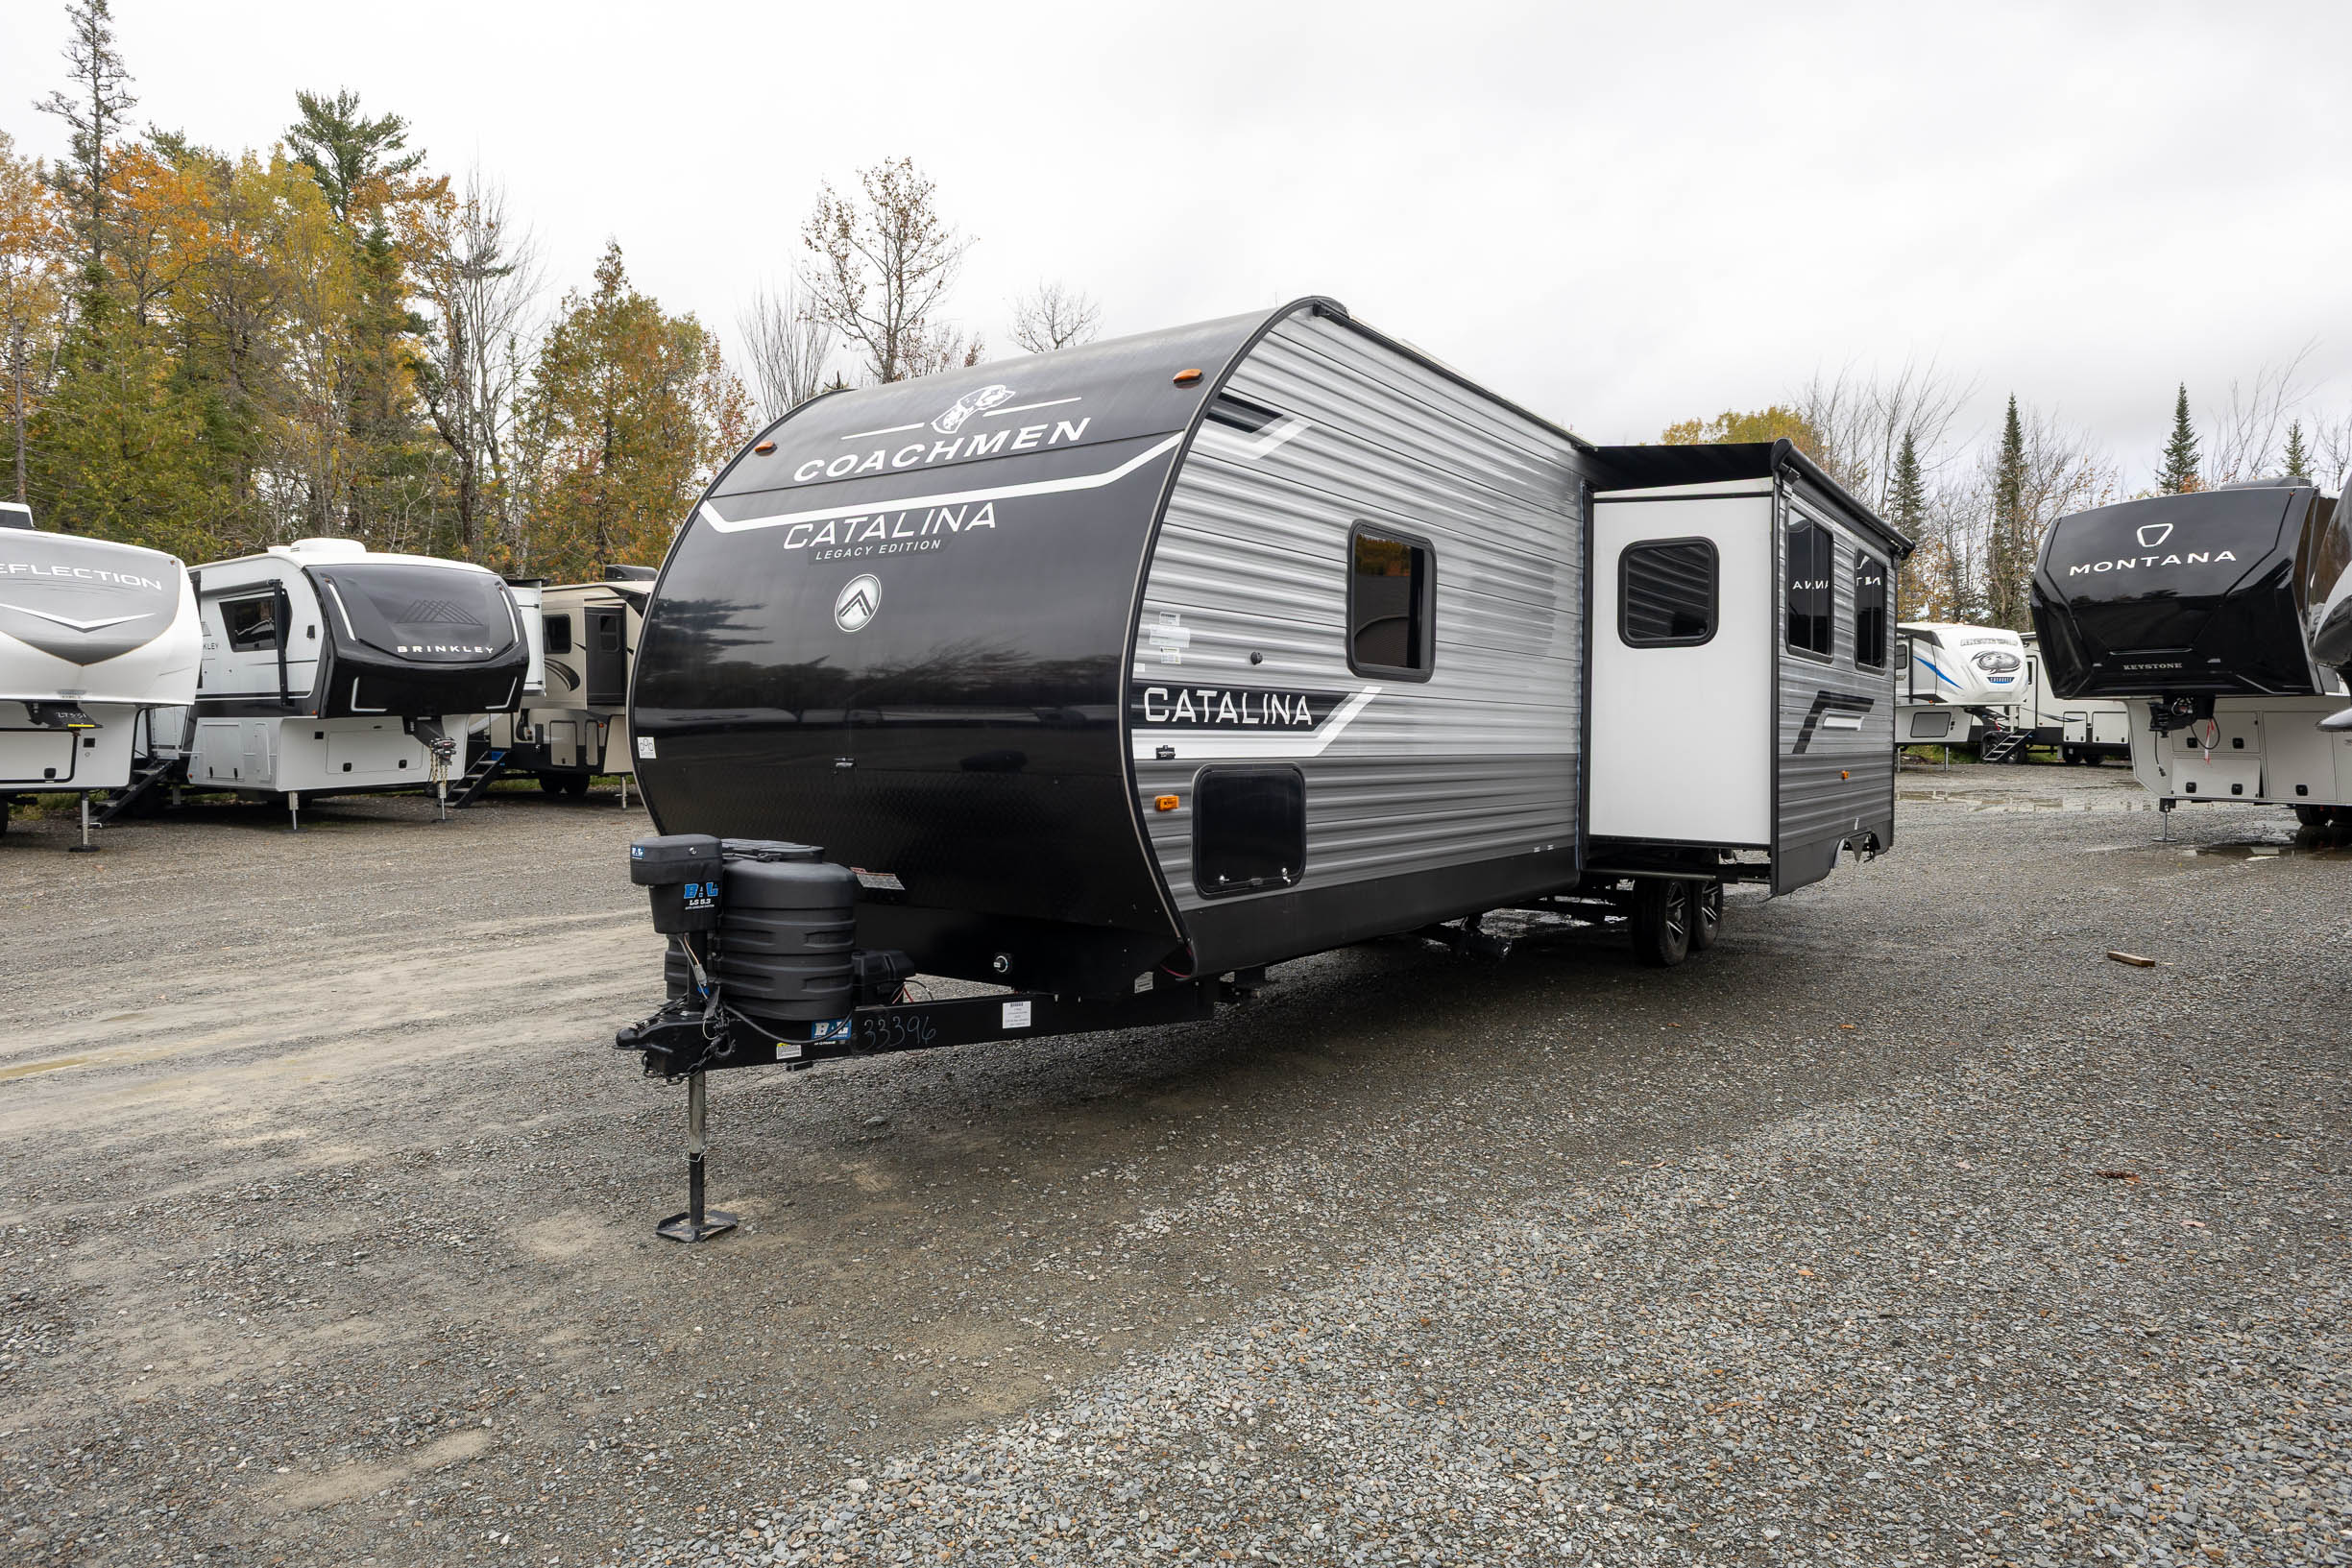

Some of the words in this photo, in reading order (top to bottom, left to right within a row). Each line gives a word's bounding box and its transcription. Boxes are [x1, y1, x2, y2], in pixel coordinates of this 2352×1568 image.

[793, 417, 1092, 482] COACHMEN
[783, 501, 996, 550] CATALINA
[815, 545, 874, 561] LEGACY
[878, 539, 942, 555] EDITION
[2069, 550, 2237, 576] MONTANA
[397, 645, 494, 654] BRINKLEY
[1144, 687, 1313, 726] CATALINA
